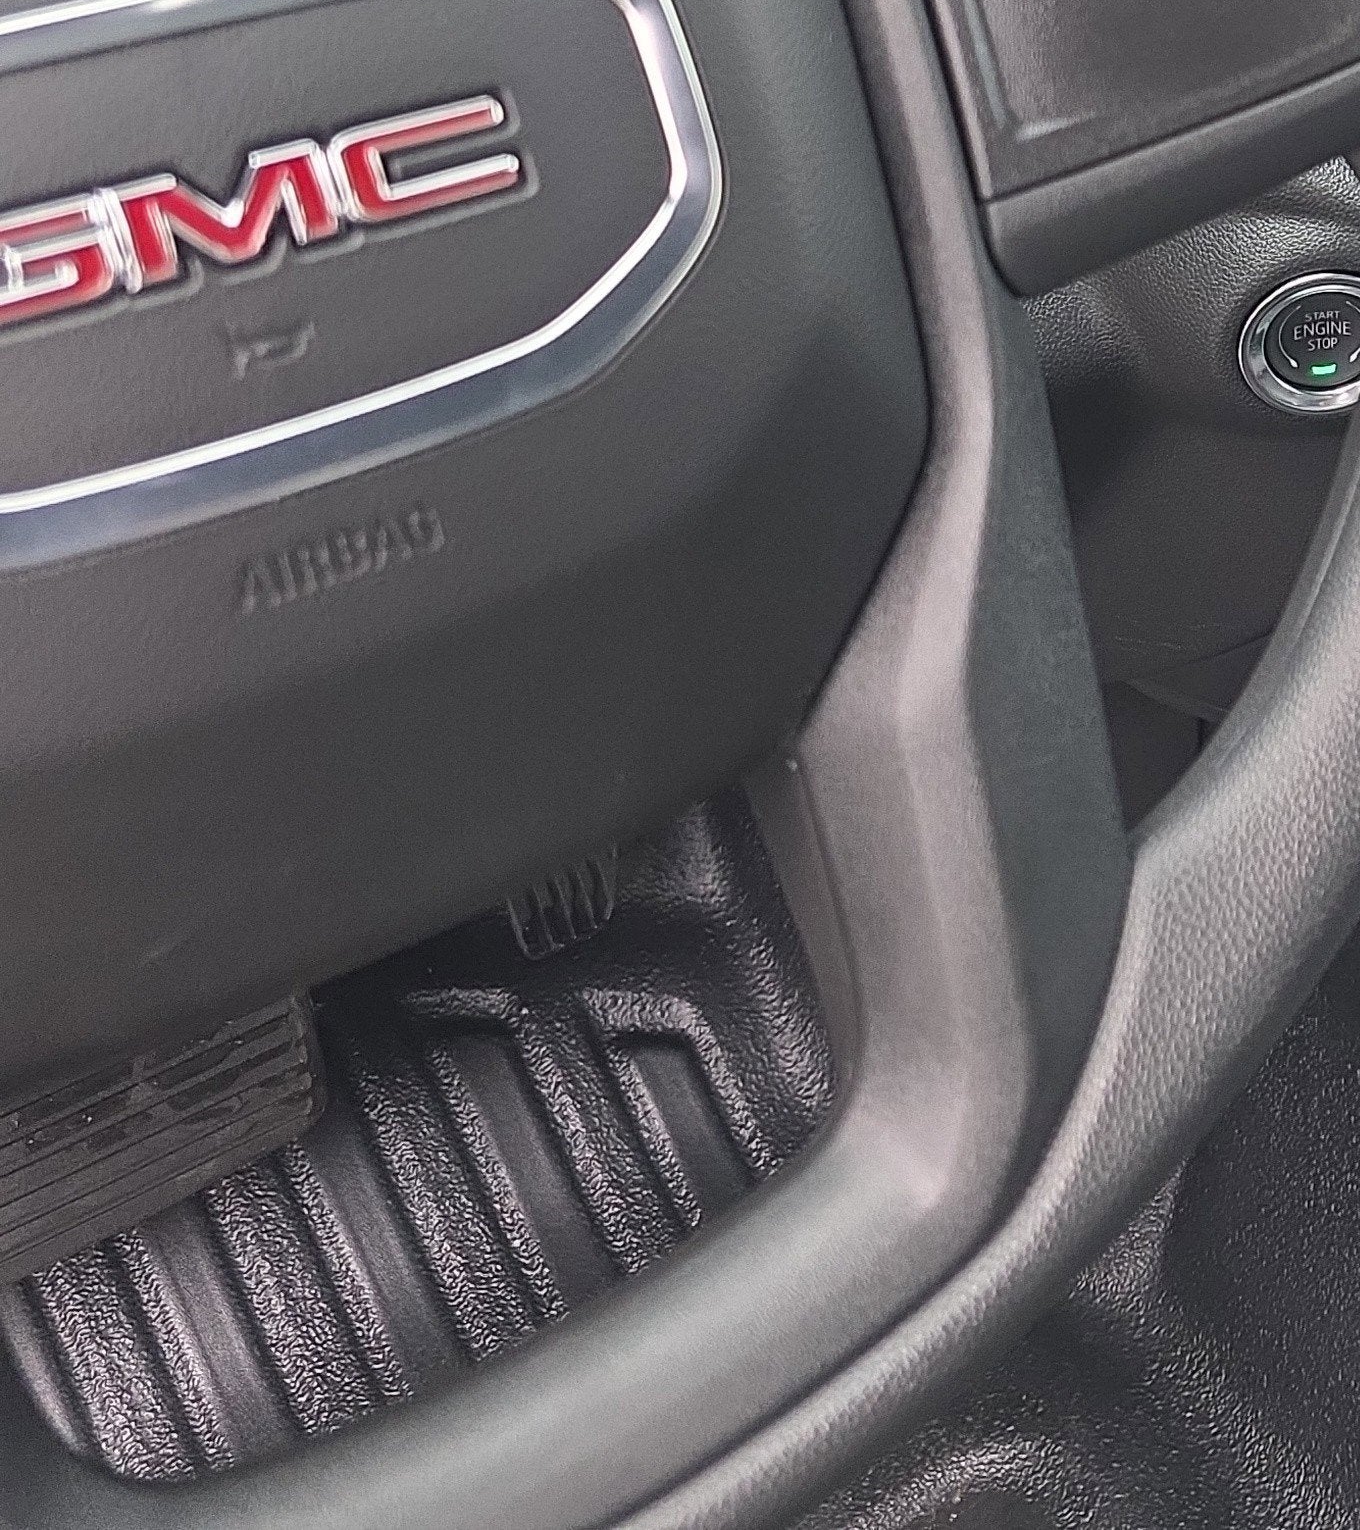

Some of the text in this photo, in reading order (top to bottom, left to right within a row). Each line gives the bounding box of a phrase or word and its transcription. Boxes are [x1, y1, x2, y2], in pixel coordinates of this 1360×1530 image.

[1305, 310, 1341, 322] START
[1293, 321, 1352, 341] ENGINE
[1308, 337, 1338, 352] STOP
